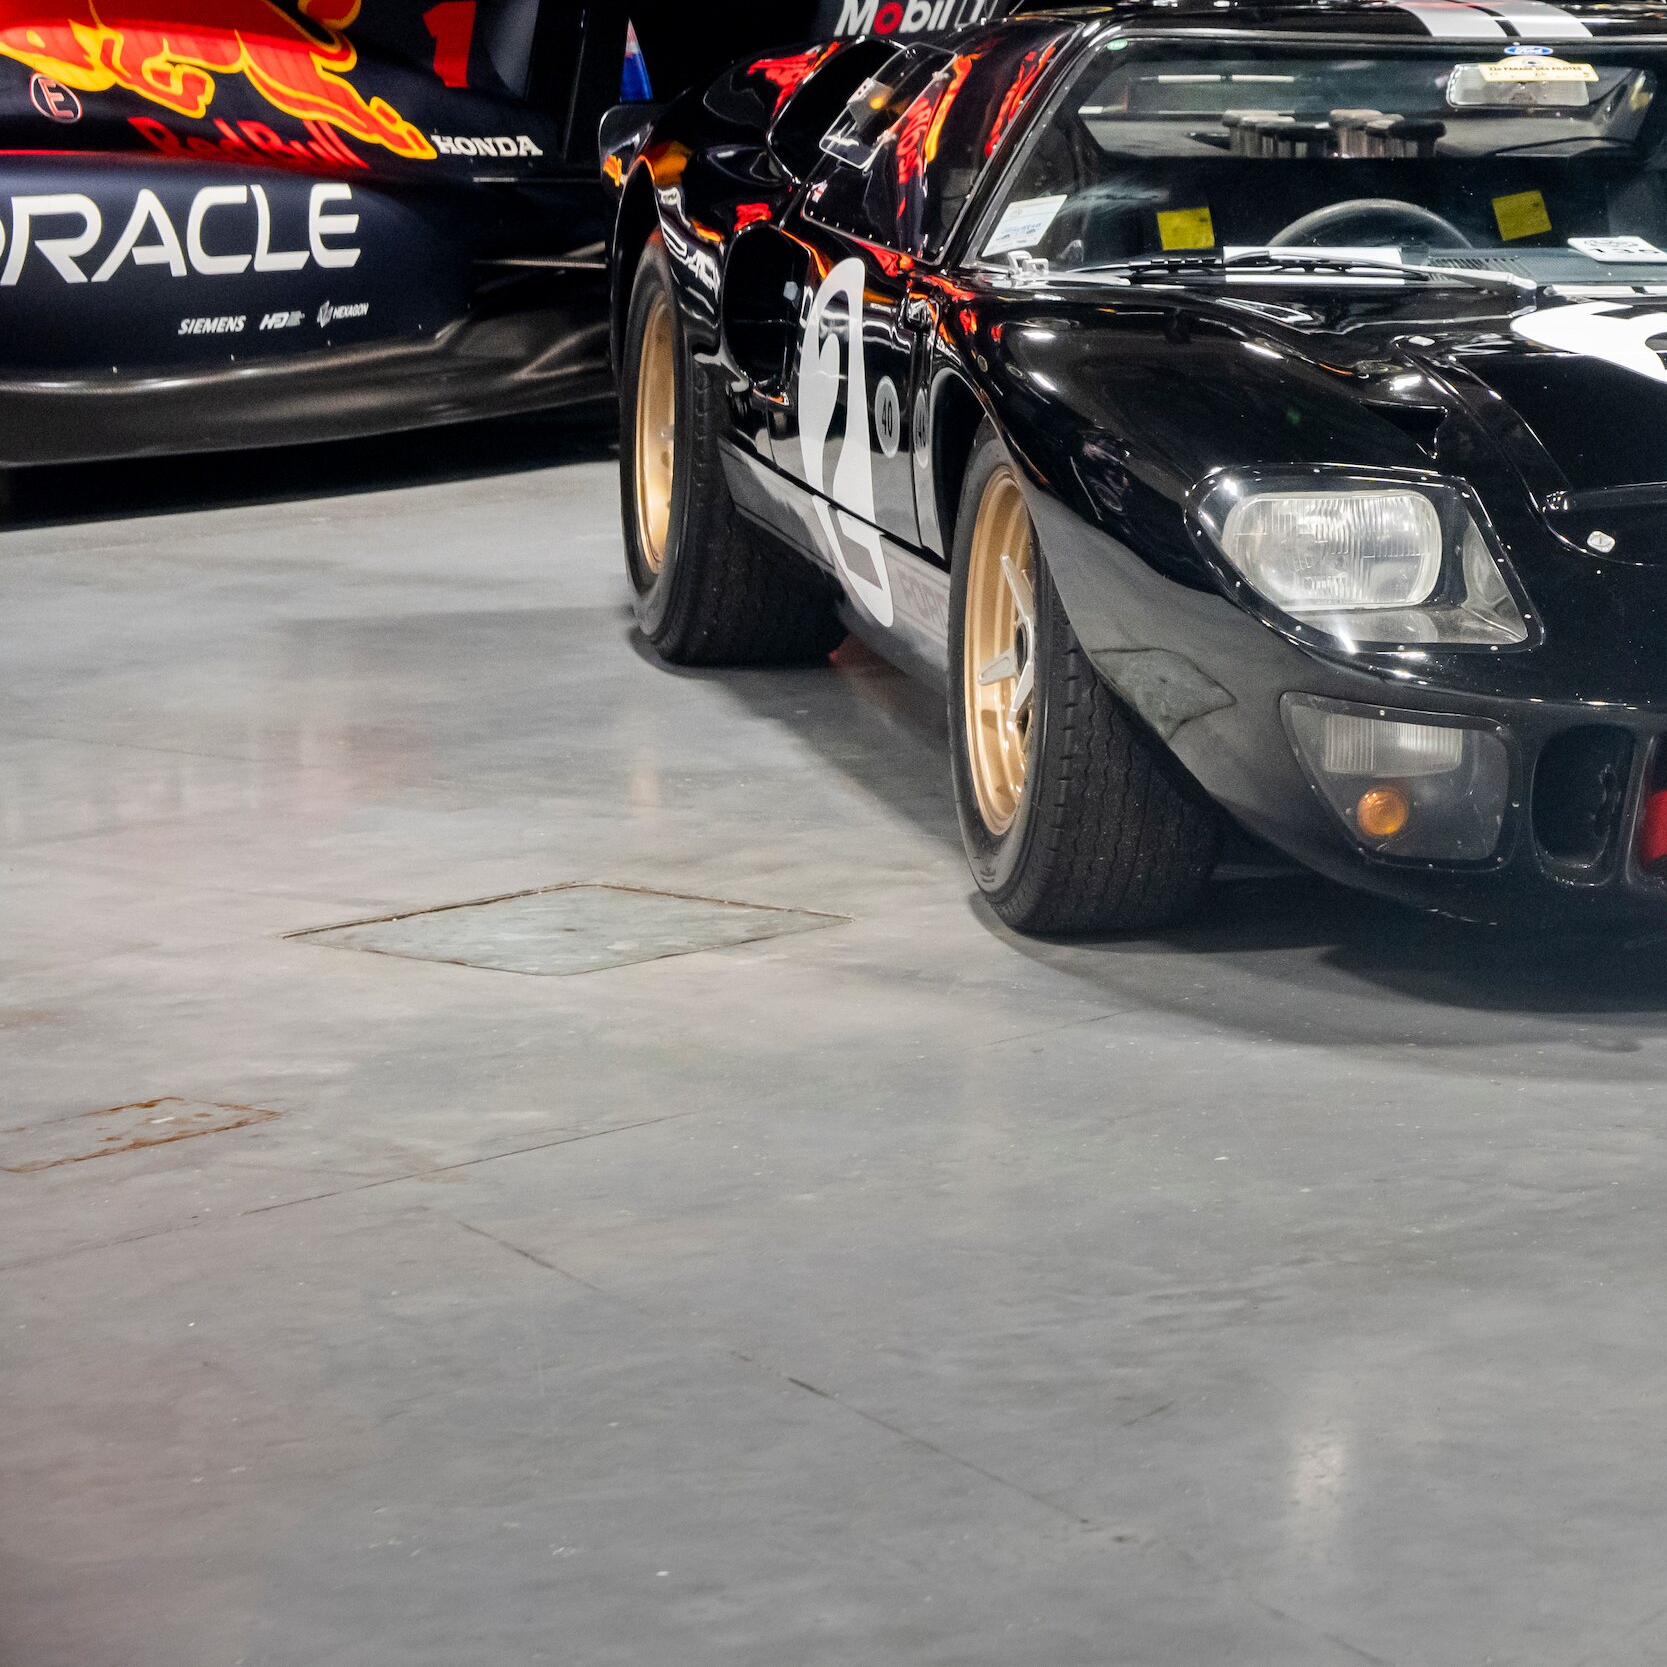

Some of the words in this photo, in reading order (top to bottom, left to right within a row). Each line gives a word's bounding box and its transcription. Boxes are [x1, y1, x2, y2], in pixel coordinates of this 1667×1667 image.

[423, 1, 476, 88] 1
[431, 135, 543, 157] HONDA
[0, 184, 361, 285] RACLE
[178, 315, 246, 335] SIEMENS
[333, 302, 370, 319] HEXAGON
[880, 396, 893, 438] 40
